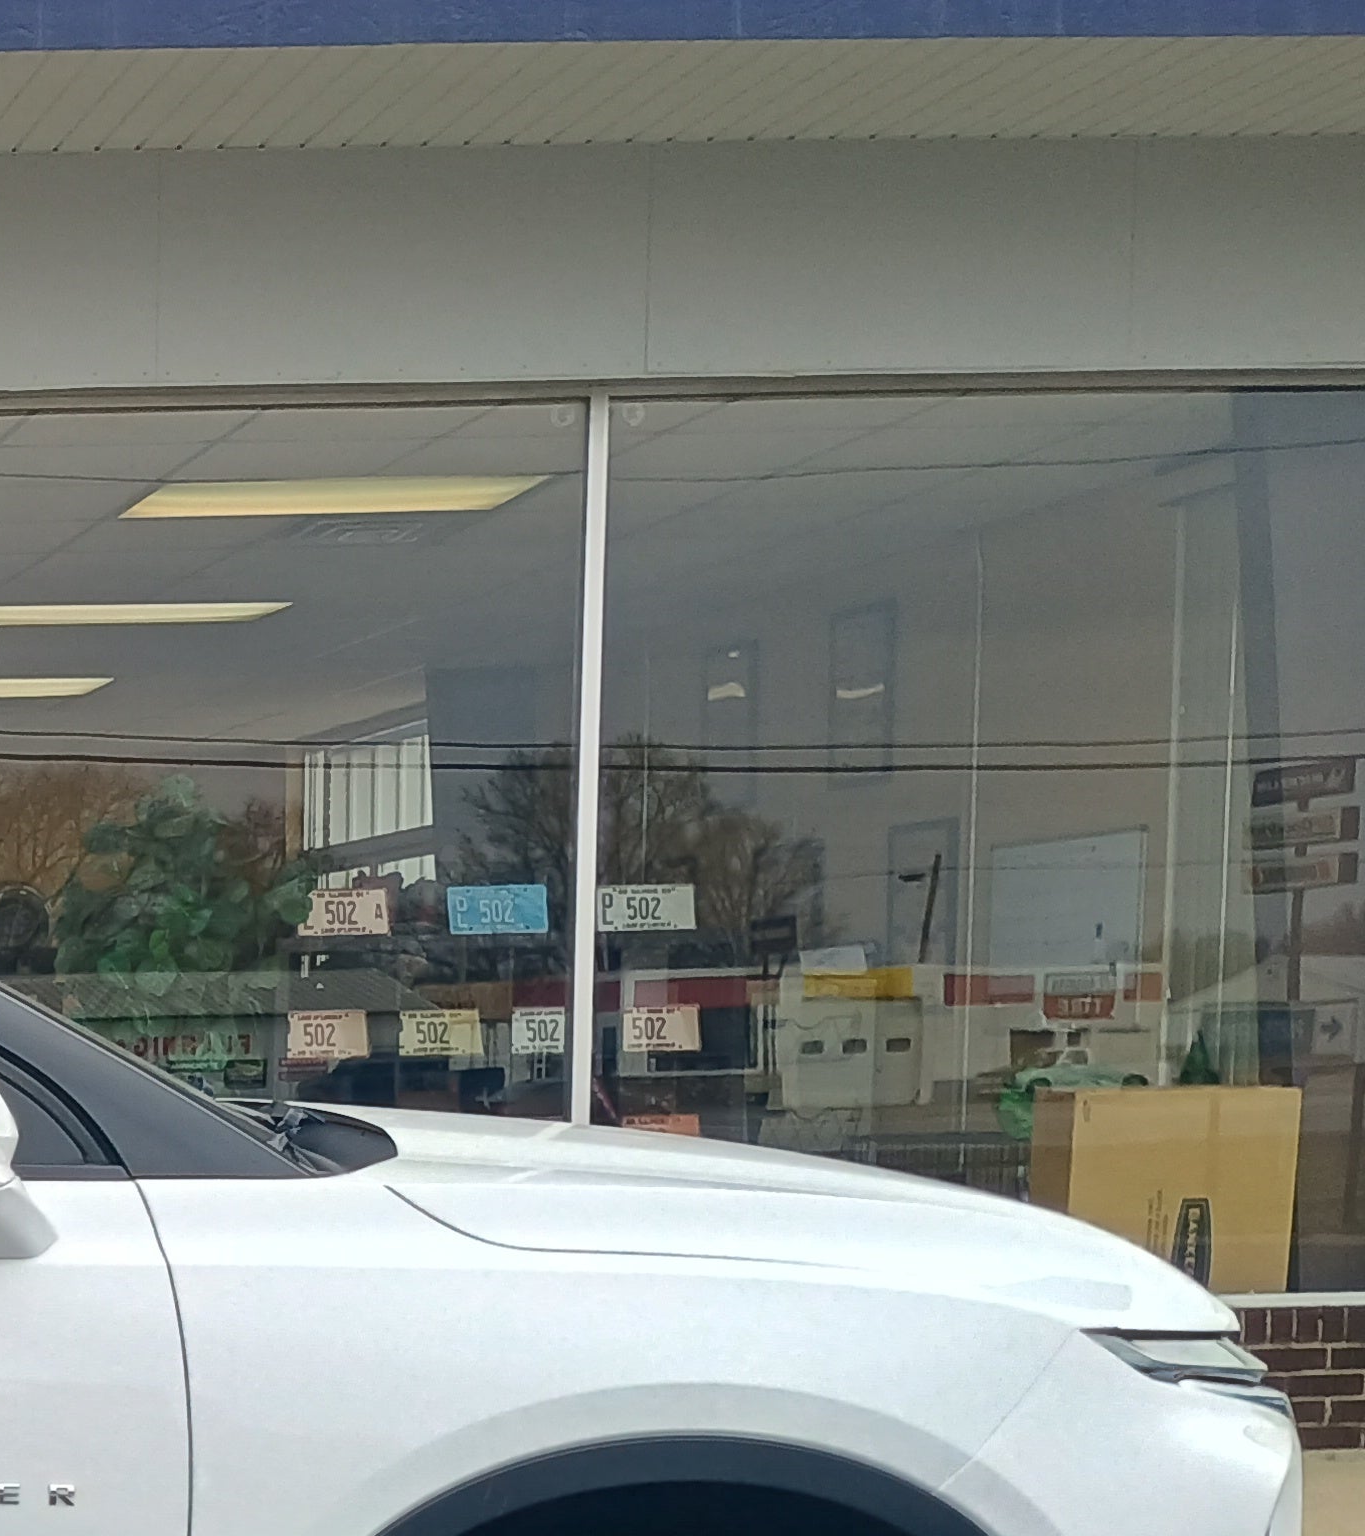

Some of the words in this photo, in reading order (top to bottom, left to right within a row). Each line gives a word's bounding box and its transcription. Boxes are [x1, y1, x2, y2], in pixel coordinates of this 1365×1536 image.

[325, 900, 358, 925] 502
[374, 903, 383, 920] A
[479, 899, 515, 924] 502
[626, 896, 662, 920] 502
[303, 1022, 336, 1047] 502
[415, 1021, 450, 1044] 502
[525, 1018, 560, 1042] 502
[632, 1016, 667, 1040] 502
